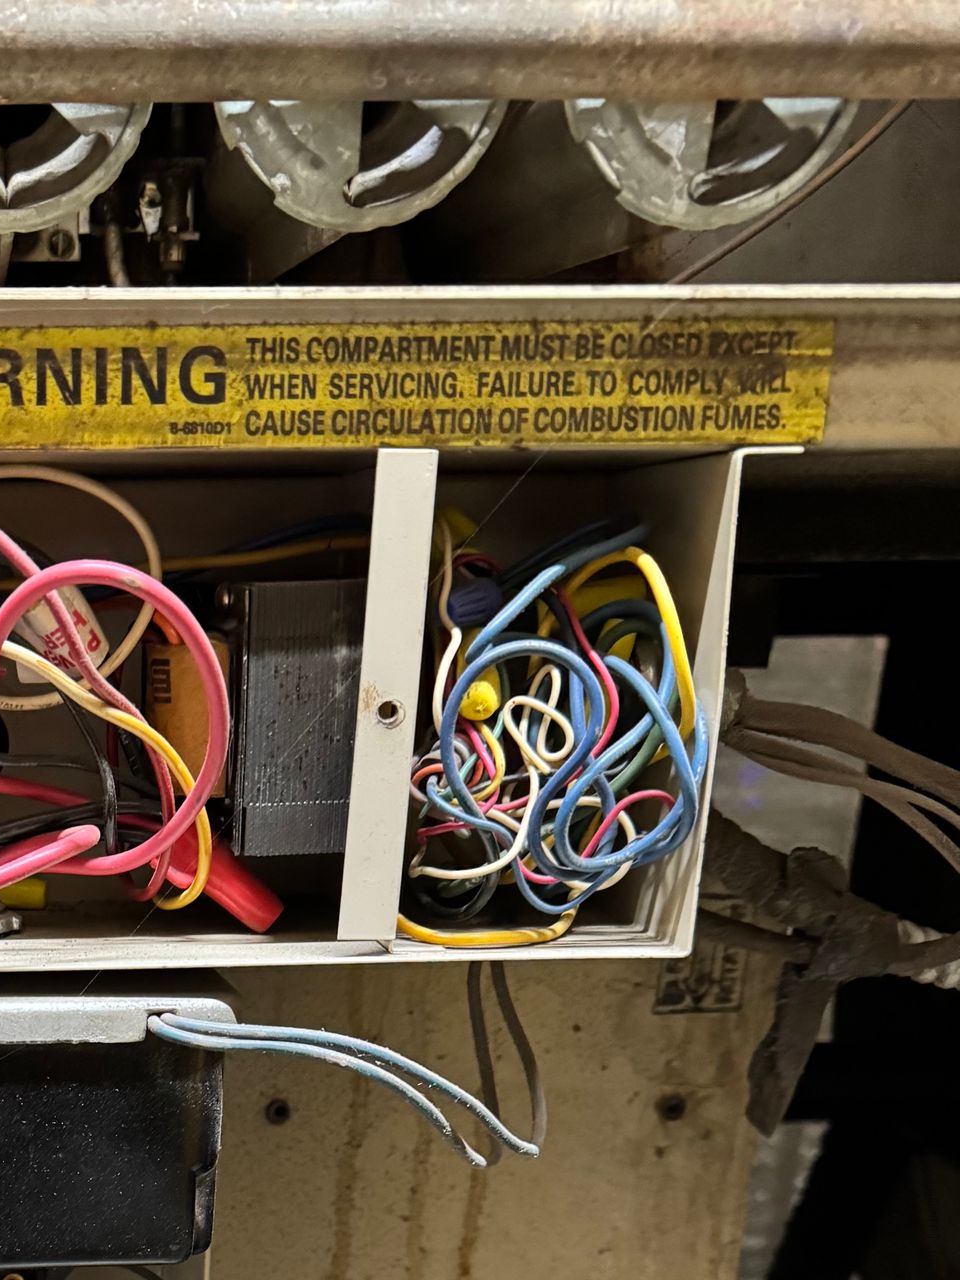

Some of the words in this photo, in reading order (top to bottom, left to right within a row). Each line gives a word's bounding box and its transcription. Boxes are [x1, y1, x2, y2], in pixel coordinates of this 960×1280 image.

[246, 337, 300, 363] THIS
[306, 335, 495, 363] COMPARTMENT
[500, 334, 570, 362] MUST
[575, 334, 605, 360] BE
[610, 332, 702, 359] CLOSED
[708, 331, 798, 357] EXCEPT
[244, 373, 317, 400] WHEN
[328, 372, 463, 399] SERVICING.
[477, 370, 576, 398] FAILURE
[587, 370, 617, 397] TO
[627, 368, 727, 396] COMPLY
[245, 409, 325, 436] CAUSE
[331, 408, 491, 436] CIRCULATION
[498, 407, 529, 434] OF
[534, 405, 695, 433] COMBUSTION
[700, 403, 787, 432] FUMES.
